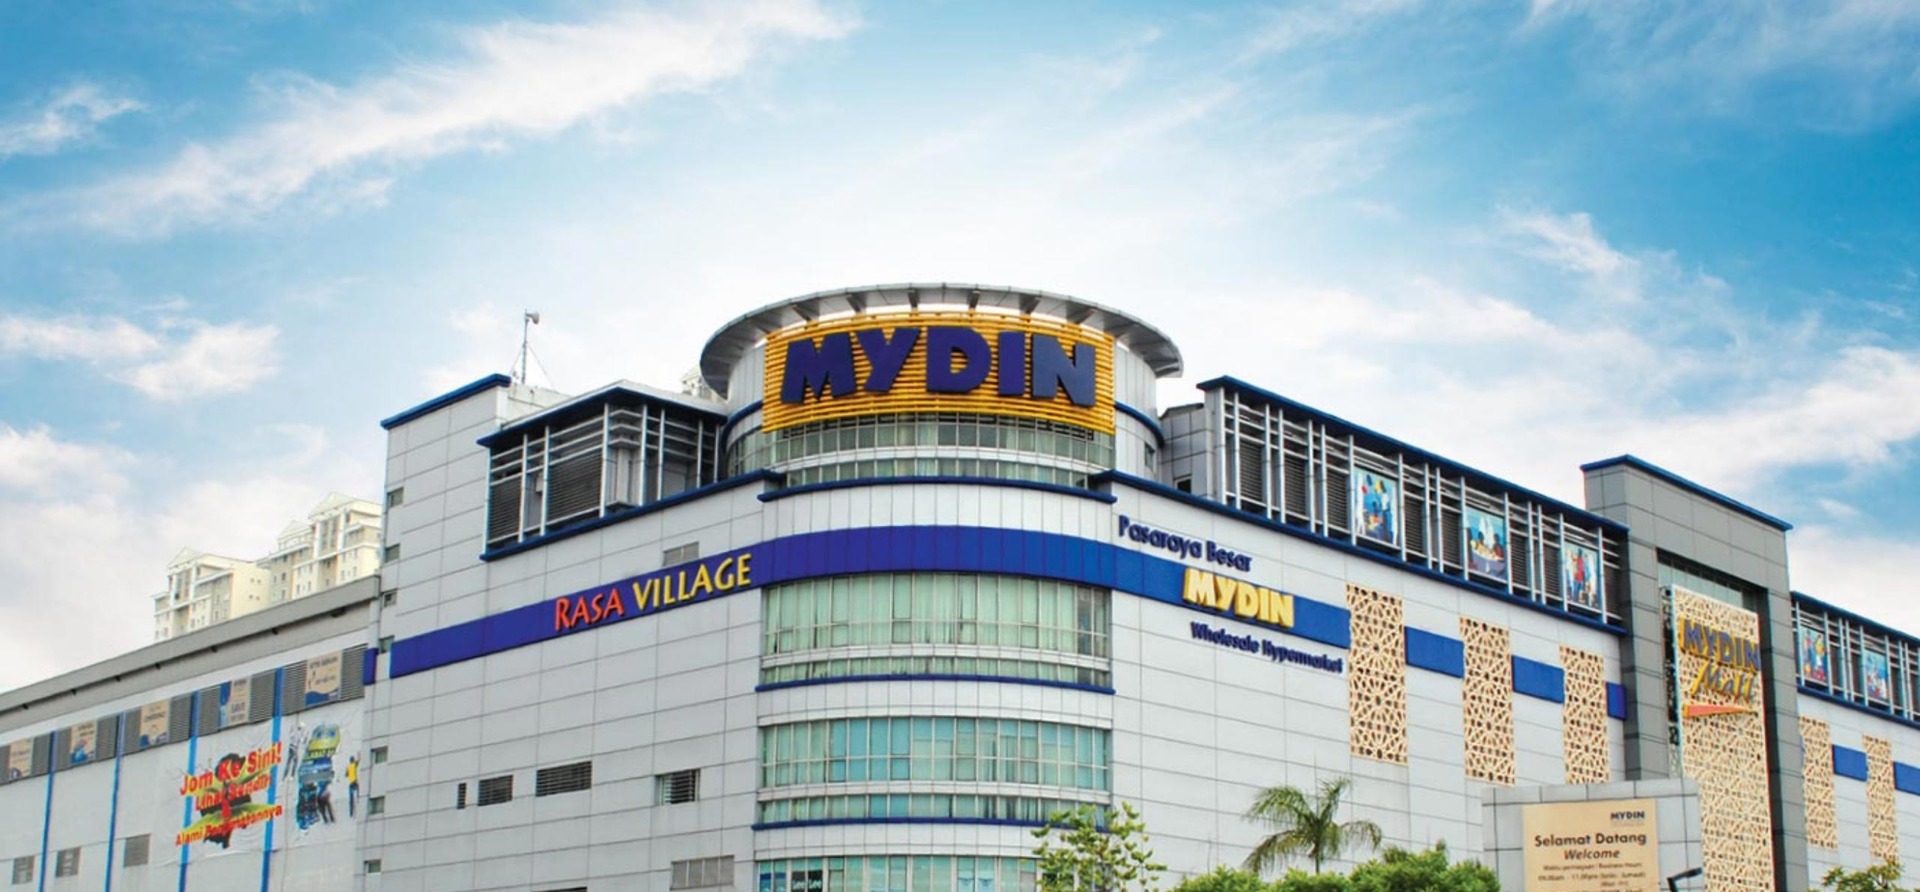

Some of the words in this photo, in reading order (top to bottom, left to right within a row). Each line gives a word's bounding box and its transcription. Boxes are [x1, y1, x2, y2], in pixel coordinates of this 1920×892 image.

[780, 326, 1097, 409] MYDIN
[1118, 515, 1202, 559] Pasaraya
[1206, 541, 1252, 572] Besar
[555, 588, 625, 631] RASA
[632, 554, 752, 611] VILLAGE
[1183, 567, 1295, 628] MYDIN
[1191, 621, 1260, 654] Wholesale
[1262, 639, 1344, 674] Hypermarket
[1678, 615, 1760, 674] MYDIN
[1690, 660, 1756, 703] Mall
[181, 771, 213, 795] Jom
[217, 759, 241, 782] Ke
[247, 741, 282, 773] Sini!
[1534, 833, 1591, 847] Selamat
[1594, 832, 1647, 845] Datang
[1610, 811, 1645, 820] MYDIN
[1564, 848, 1620, 860] Welcome
